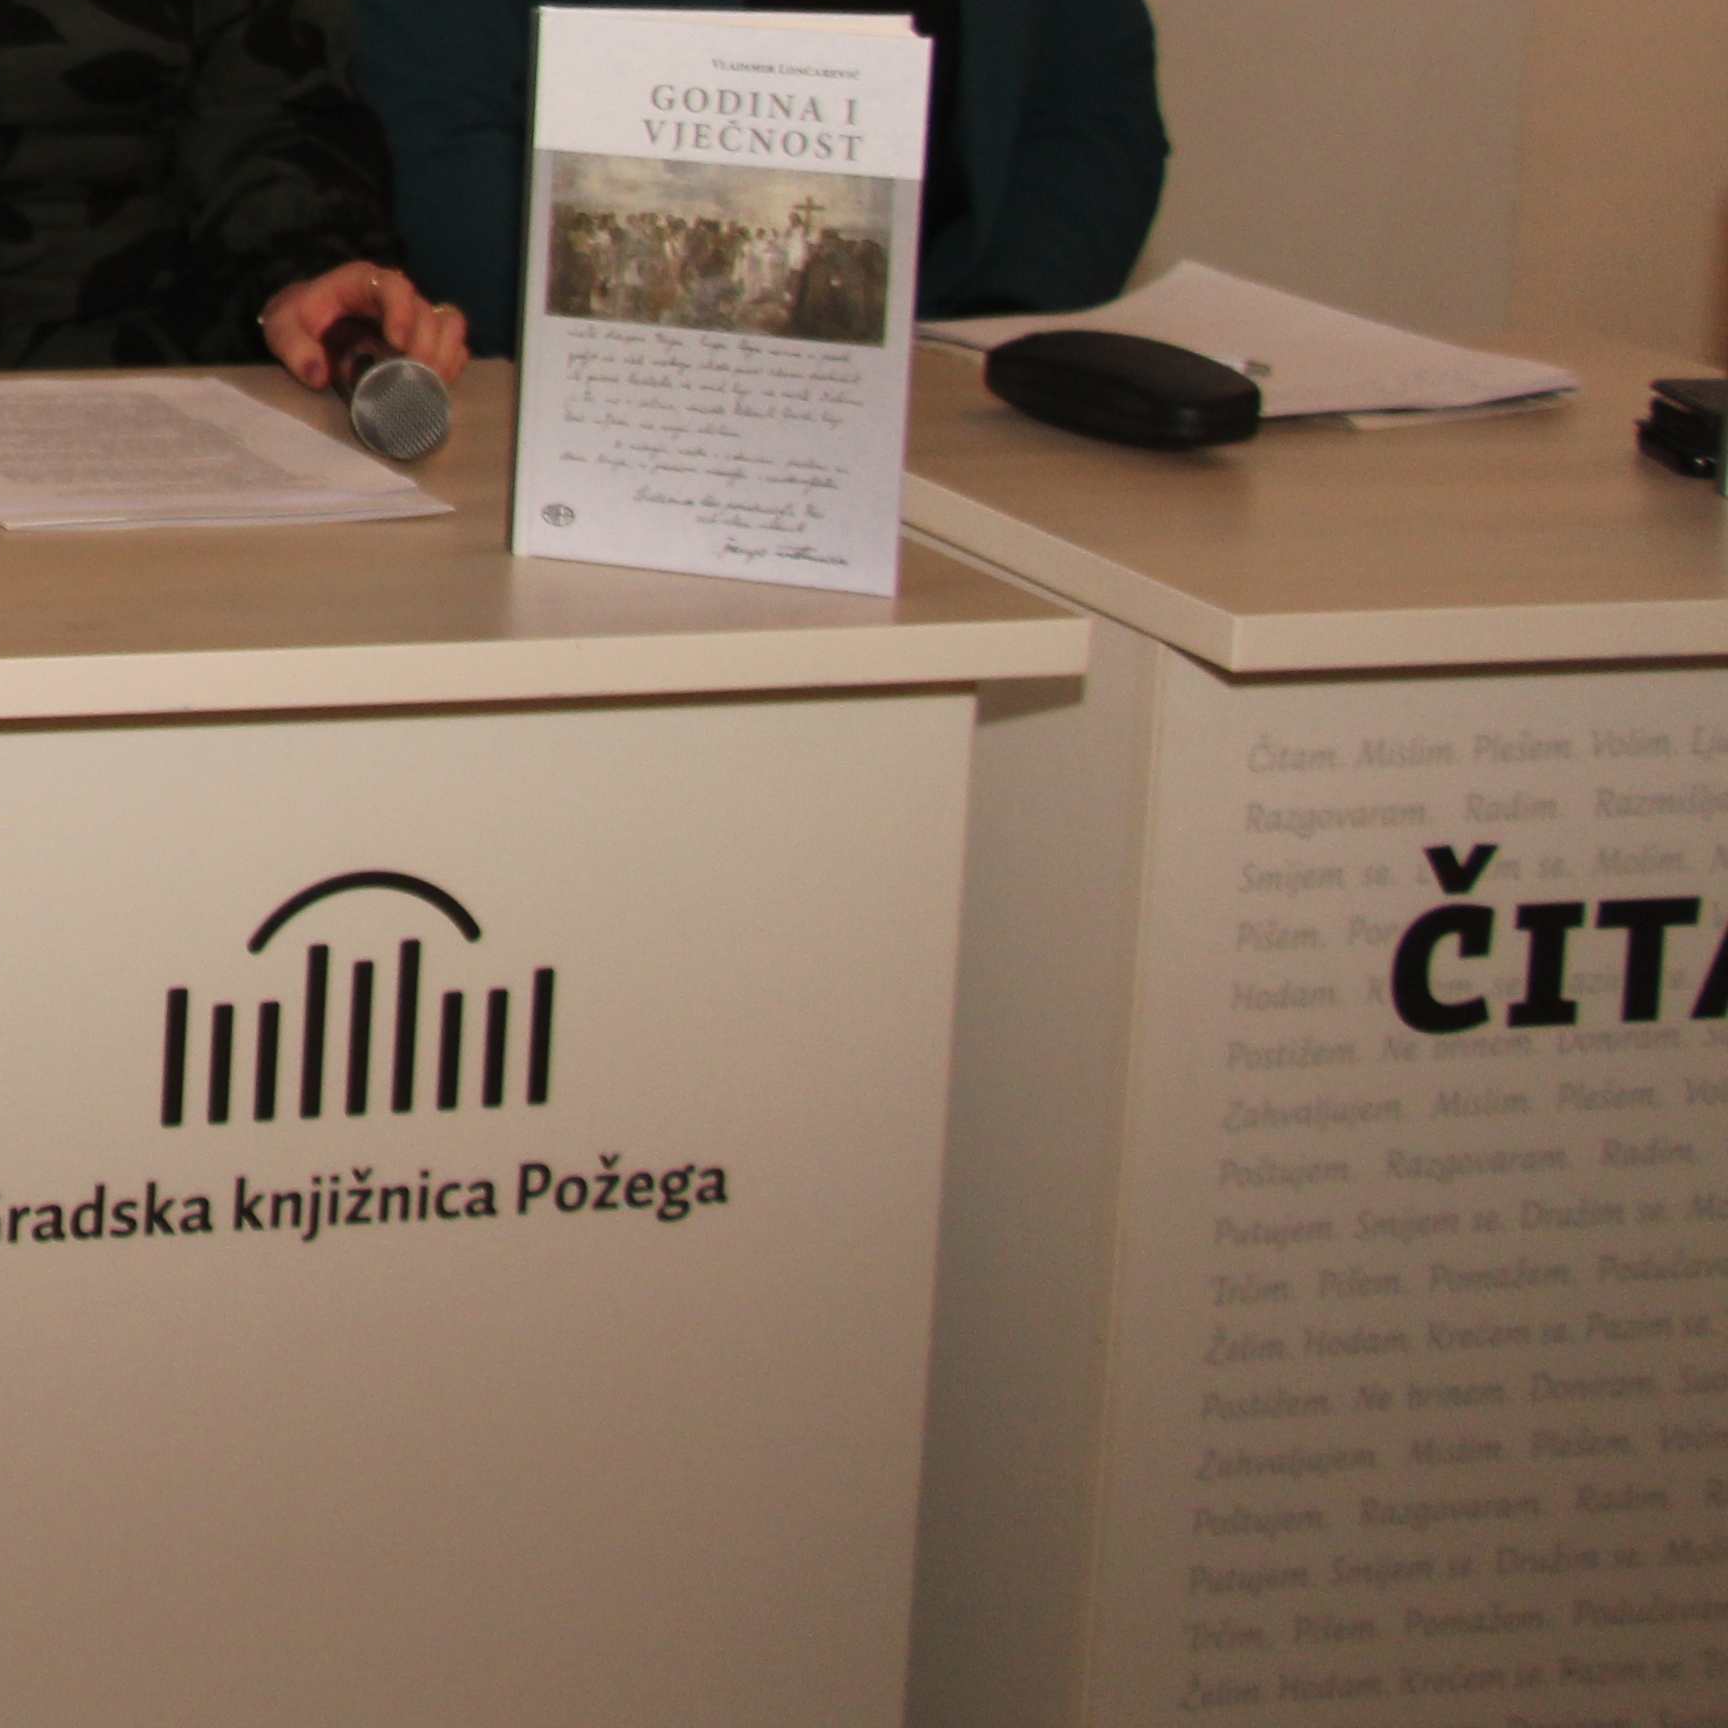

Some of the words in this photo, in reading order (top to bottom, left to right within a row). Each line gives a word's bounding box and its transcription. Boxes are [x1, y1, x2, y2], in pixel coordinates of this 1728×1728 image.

[650, 83, 824, 123] GODINA
[844, 97, 858, 126] I
[642, 117, 863, 162] VJEČNOST
[1390, 842, 1728, 1036] ČIT
[232, 1167, 498, 1243] knjižnica
[516, 1153, 731, 1222] Požega
